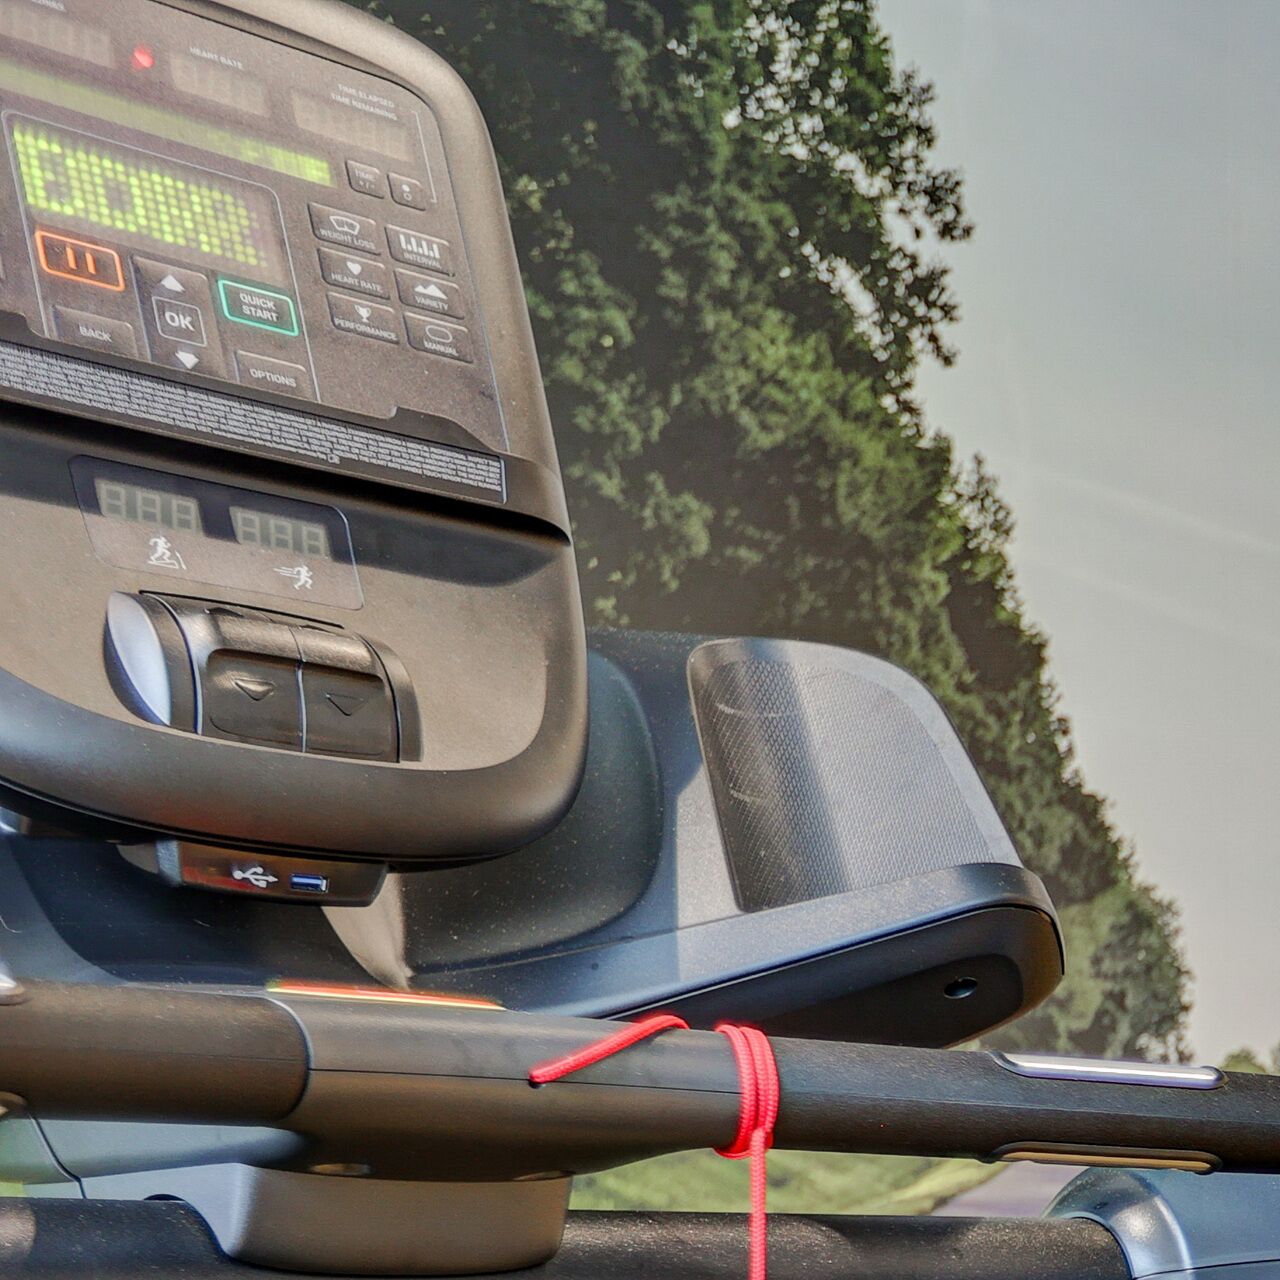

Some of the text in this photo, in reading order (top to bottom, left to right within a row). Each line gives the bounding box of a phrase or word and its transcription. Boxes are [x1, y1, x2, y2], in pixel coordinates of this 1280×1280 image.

[221, 55, 243, 70] RATE
[319, 228, 376, 250] WEIGHT LOSS
[403, 252, 442, 270] INTERVAL
[331, 272, 383, 293] HEART RATE
[238, 292, 277, 311] QUICK
[415, 295, 449, 311] VARIETY
[164, 310, 196, 332] OK
[241, 305, 280, 323] START
[78, 325, 113, 343] BACK
[333, 317, 398, 341] PERFORMANCE
[423, 340, 460, 357] MANUAL
[248, 368, 298, 388] OPTIONS
